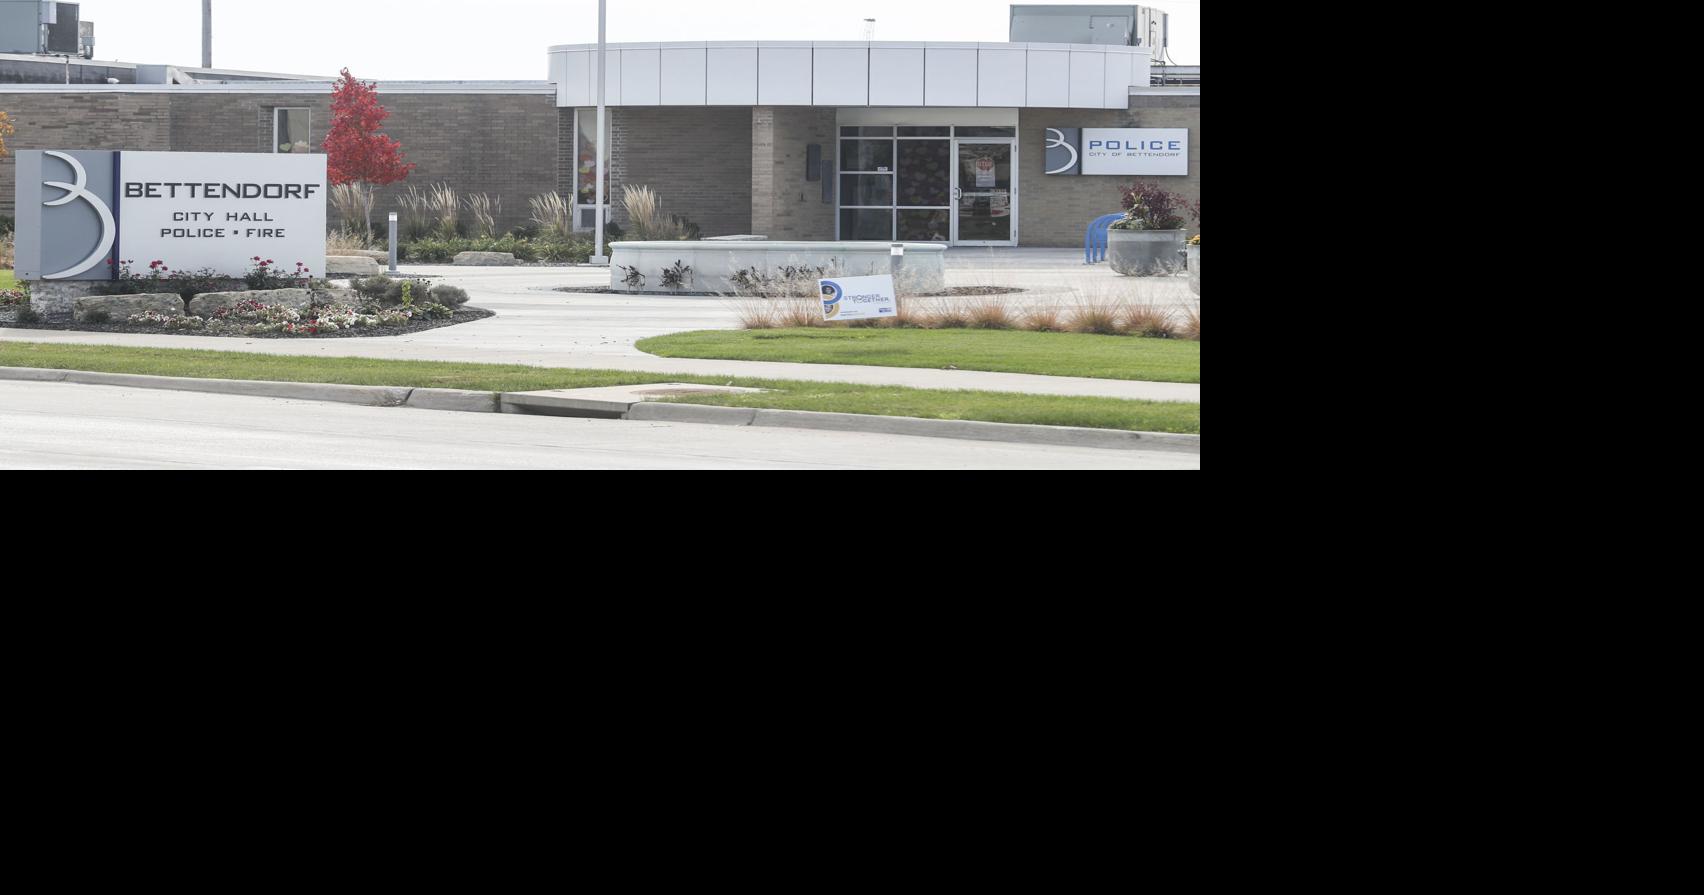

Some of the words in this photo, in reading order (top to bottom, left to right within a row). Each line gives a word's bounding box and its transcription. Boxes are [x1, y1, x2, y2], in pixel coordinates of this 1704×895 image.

[1088, 140, 1181, 150] POLICE
[124, 181, 320, 199] BETTENDORF
[172, 211, 215, 222] CITY
[225, 211, 274, 222] HALL
[160, 228, 225, 238] POLICE
[246, 228, 286, 238] FIRE
